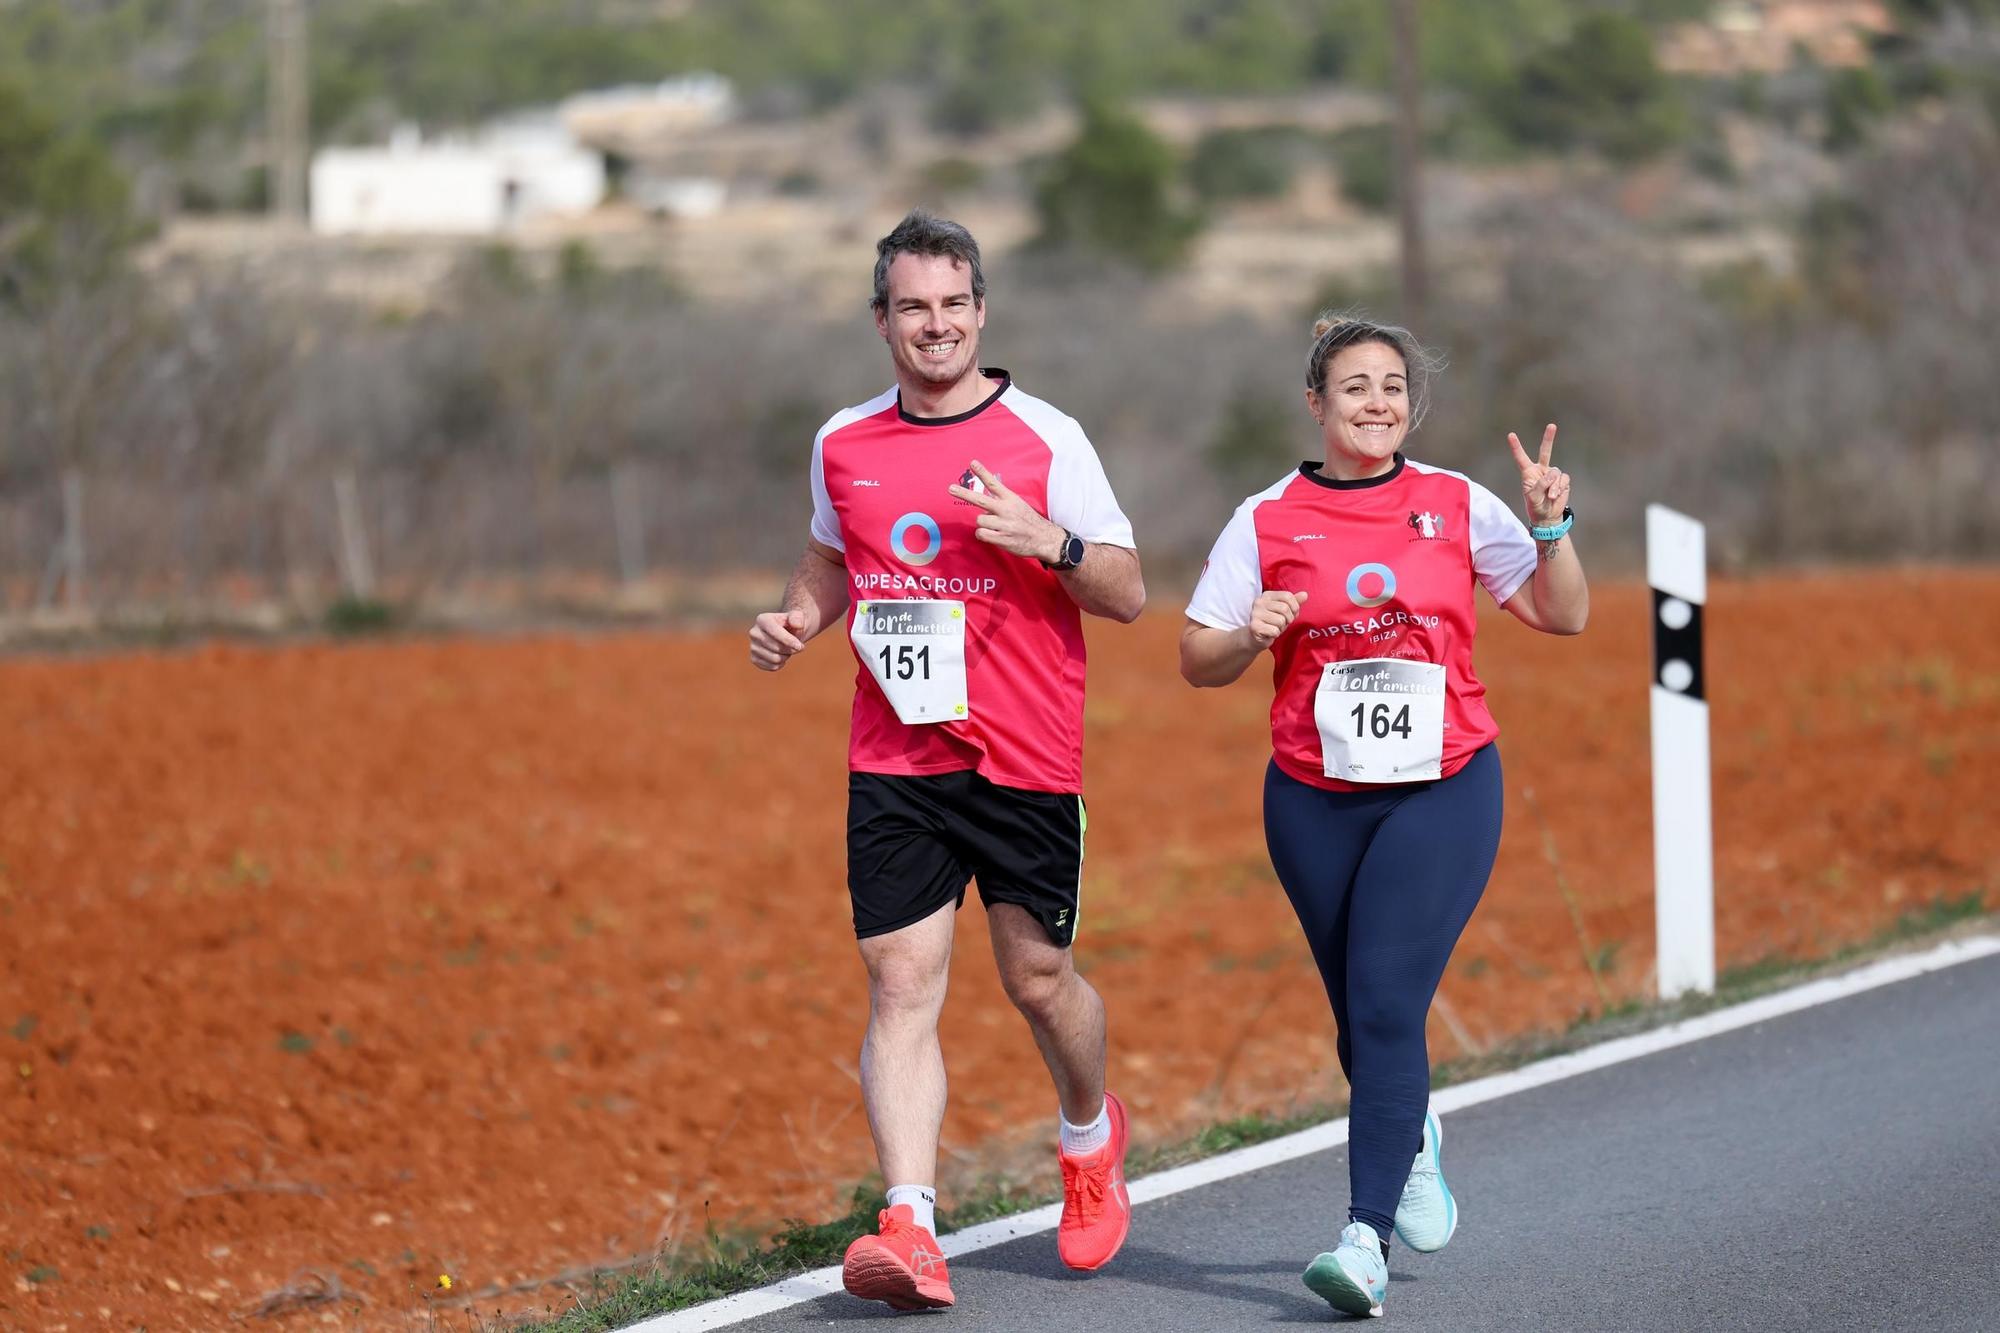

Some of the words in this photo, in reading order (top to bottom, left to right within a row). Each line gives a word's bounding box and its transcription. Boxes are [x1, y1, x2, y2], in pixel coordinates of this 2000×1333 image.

[854, 573, 996, 594] DIPESAGROUP
[899, 611, 913, 622] de
[1308, 611, 1439, 639] DIPESAGROUP
[1369, 630, 1398, 644] IBIZA
[879, 644, 930, 680] 151
[1375, 669, 1391, 680] de
[1351, 703, 1412, 739] 164
